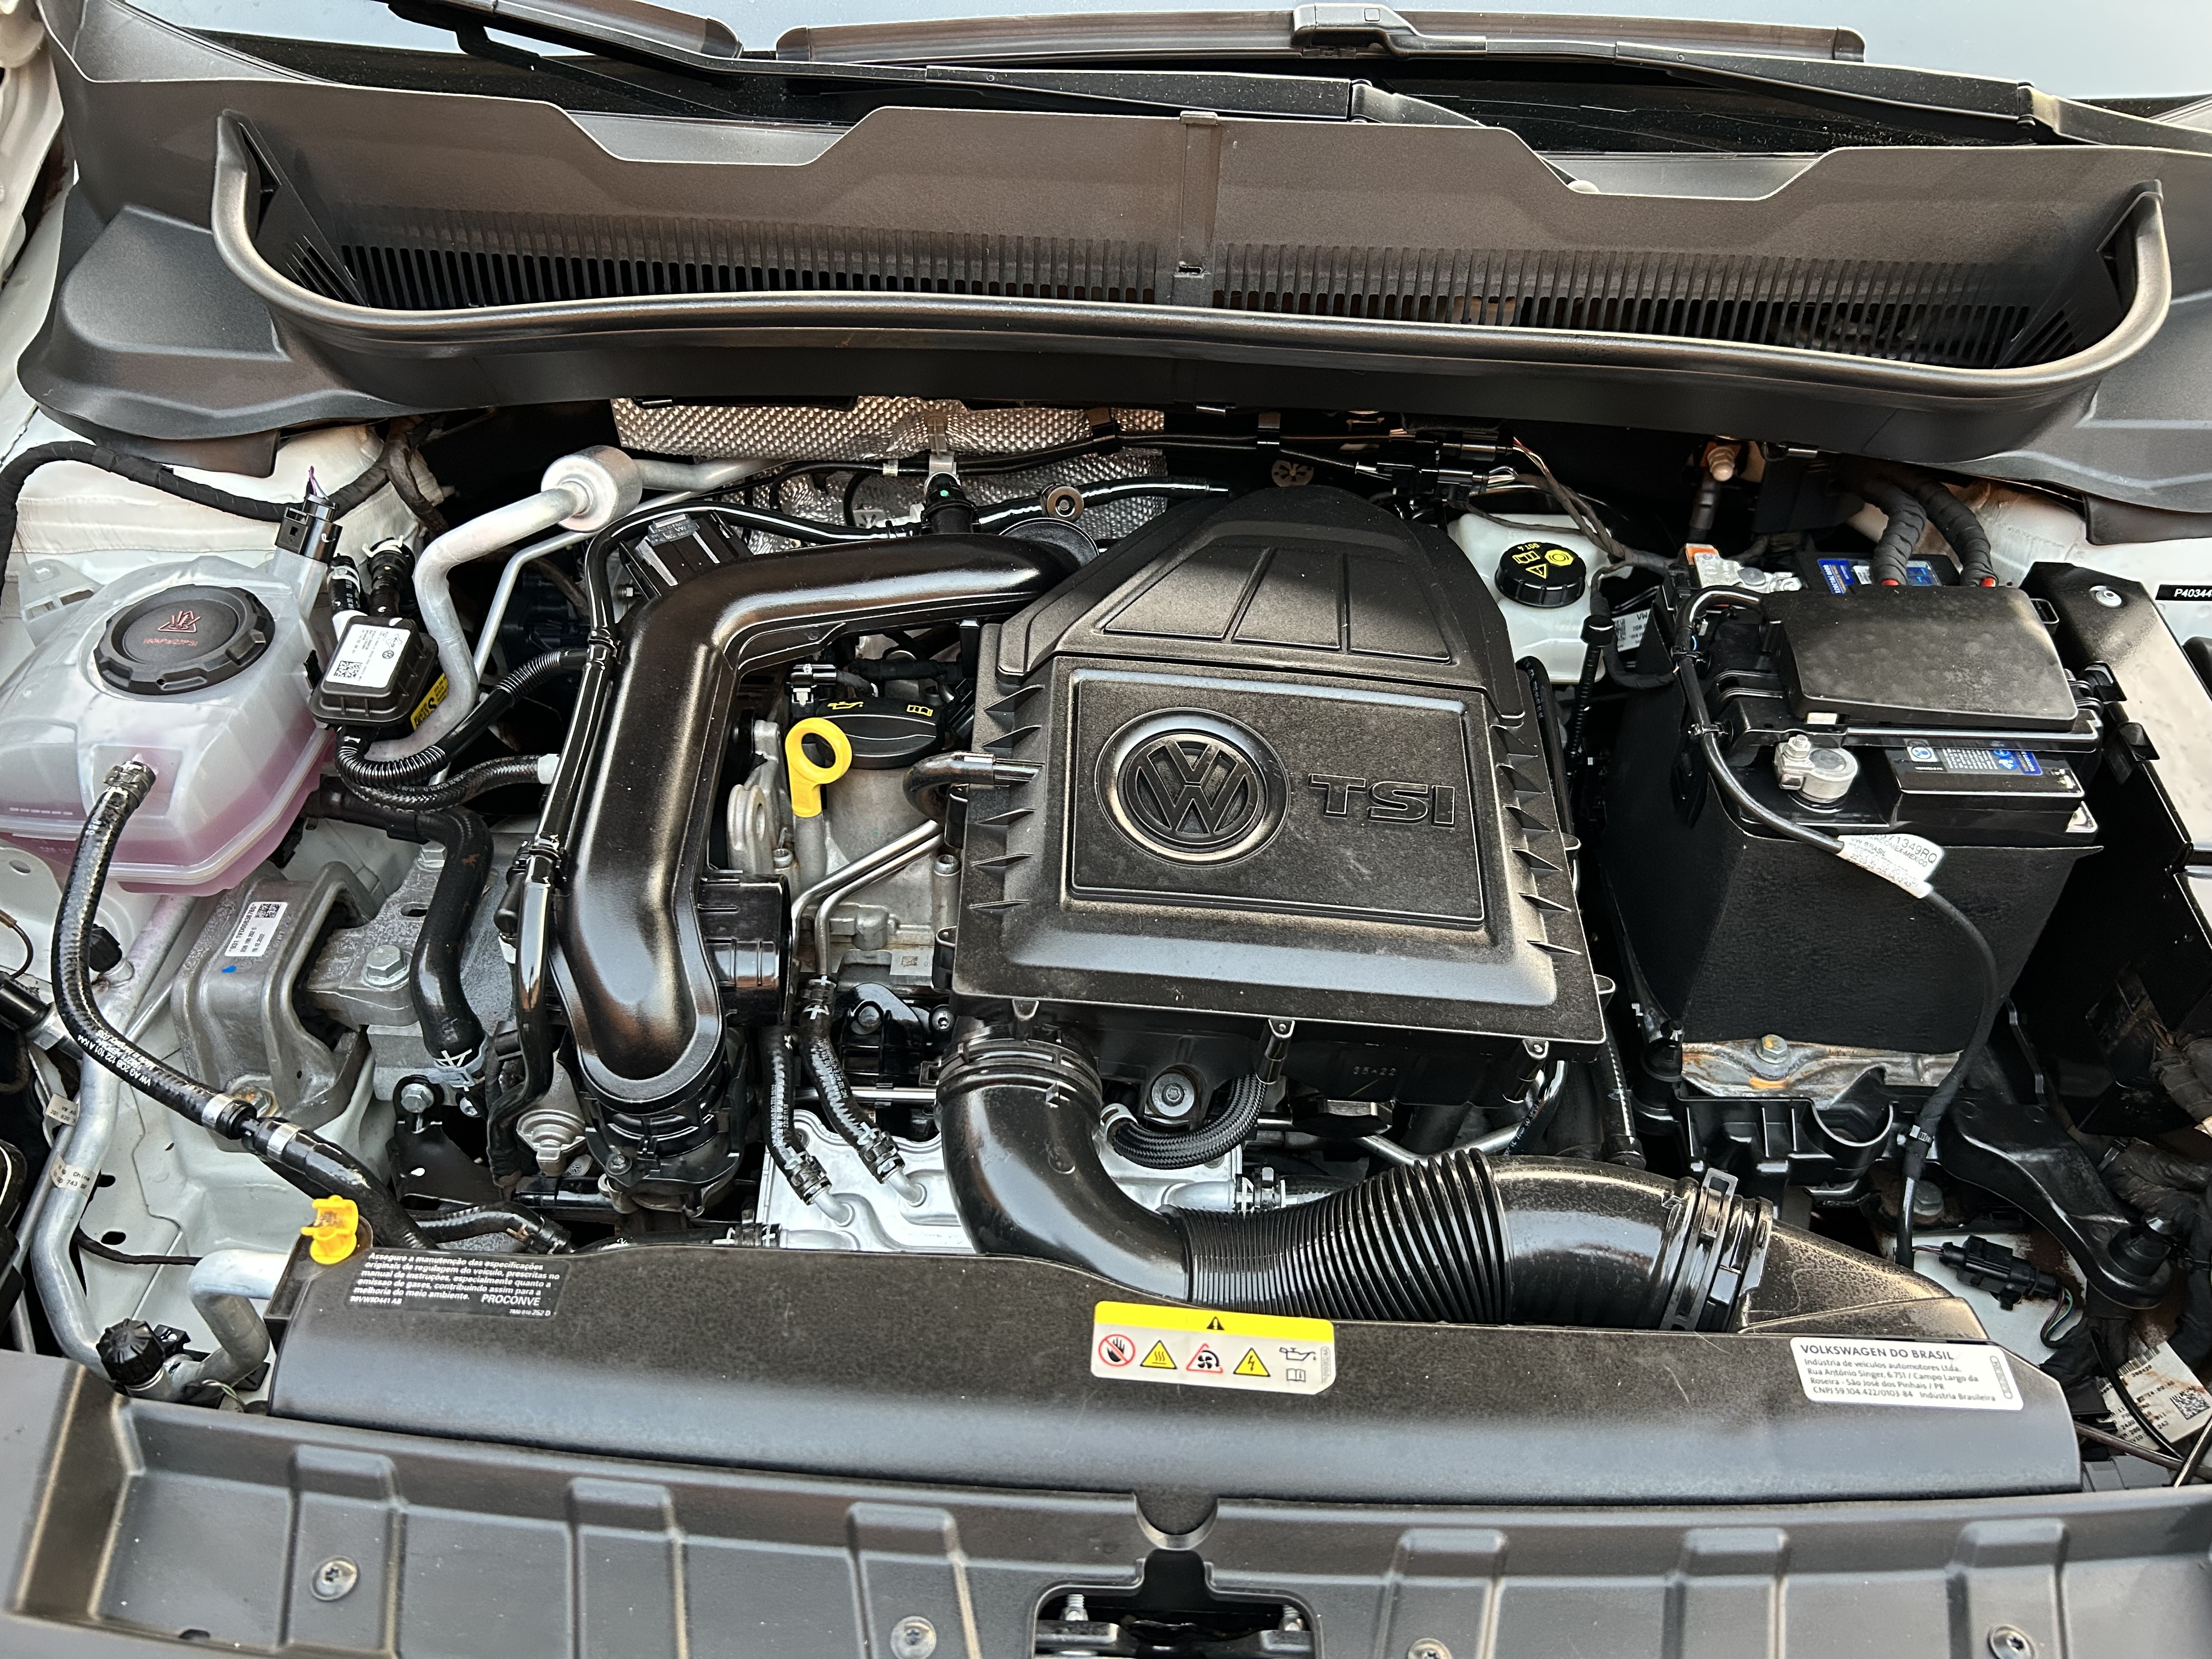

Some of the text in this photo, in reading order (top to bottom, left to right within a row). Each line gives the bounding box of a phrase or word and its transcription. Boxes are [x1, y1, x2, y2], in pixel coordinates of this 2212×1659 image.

[1308, 773, 1456, 828] TSI
[1865, 842, 1886, 856] BRASIL
[94, 1047, 105, 1057] 101
[105, 1053, 117, 1064] 122
[129, 1069, 141, 1079] AG
[139, 1075, 151, 1086] VW
[73, 1171, 90, 1181] China
[369, 1253, 407, 1261] Assegure
[416, 1256, 466, 1266] manutenção
[484, 1261, 543, 1270] especificações
[365, 1261, 400, 1269] originais
[415, 1265, 459, 1273] regulagem
[506, 1271, 547, 1279] prescritas
[453, 1276, 513, 1285] especialmente
[434, 1283, 487, 1292] contribuindo
[353, 1286, 392, 1295] melhoria
[428, 1290, 470, 1300] ambiente.
[481, 1294, 541, 1306] PROCONVE
[1800, 1345, 1954, 1359] VOLKSWAGEN DO BRASIL
[1888, 1363, 1940, 1371] automotores
[1913, 1373, 1942, 1381] Campo
[1944, 1374, 1966, 1383] Largo
[1919, 1391, 1956, 1400] Indústria
[1958, 1393, 1996, 1401] Brasileira
